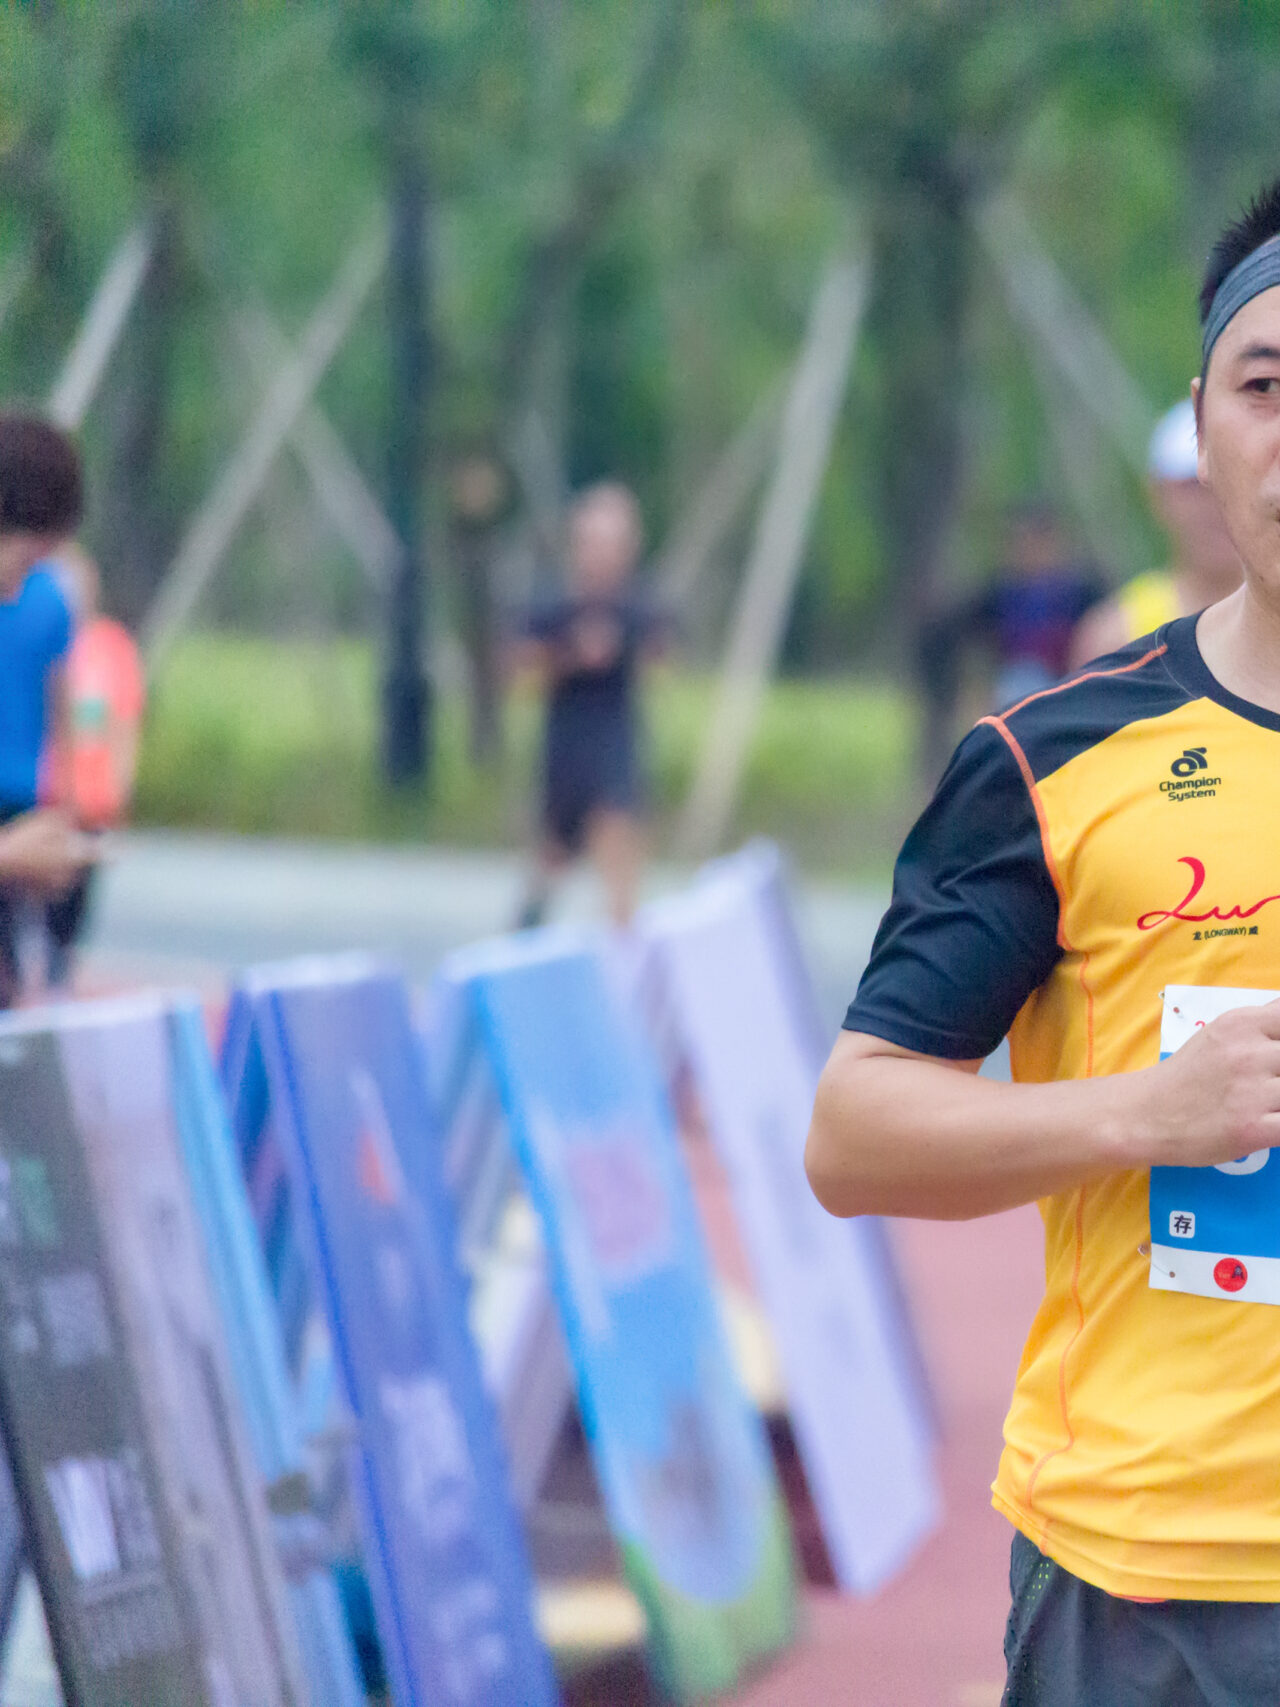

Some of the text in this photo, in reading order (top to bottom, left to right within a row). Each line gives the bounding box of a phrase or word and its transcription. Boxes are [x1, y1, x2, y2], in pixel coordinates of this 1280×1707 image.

[1159, 776, 1222, 792] Champion
[1168, 789, 1216, 802] System
[1173, 1214, 1193, 1236] 存
